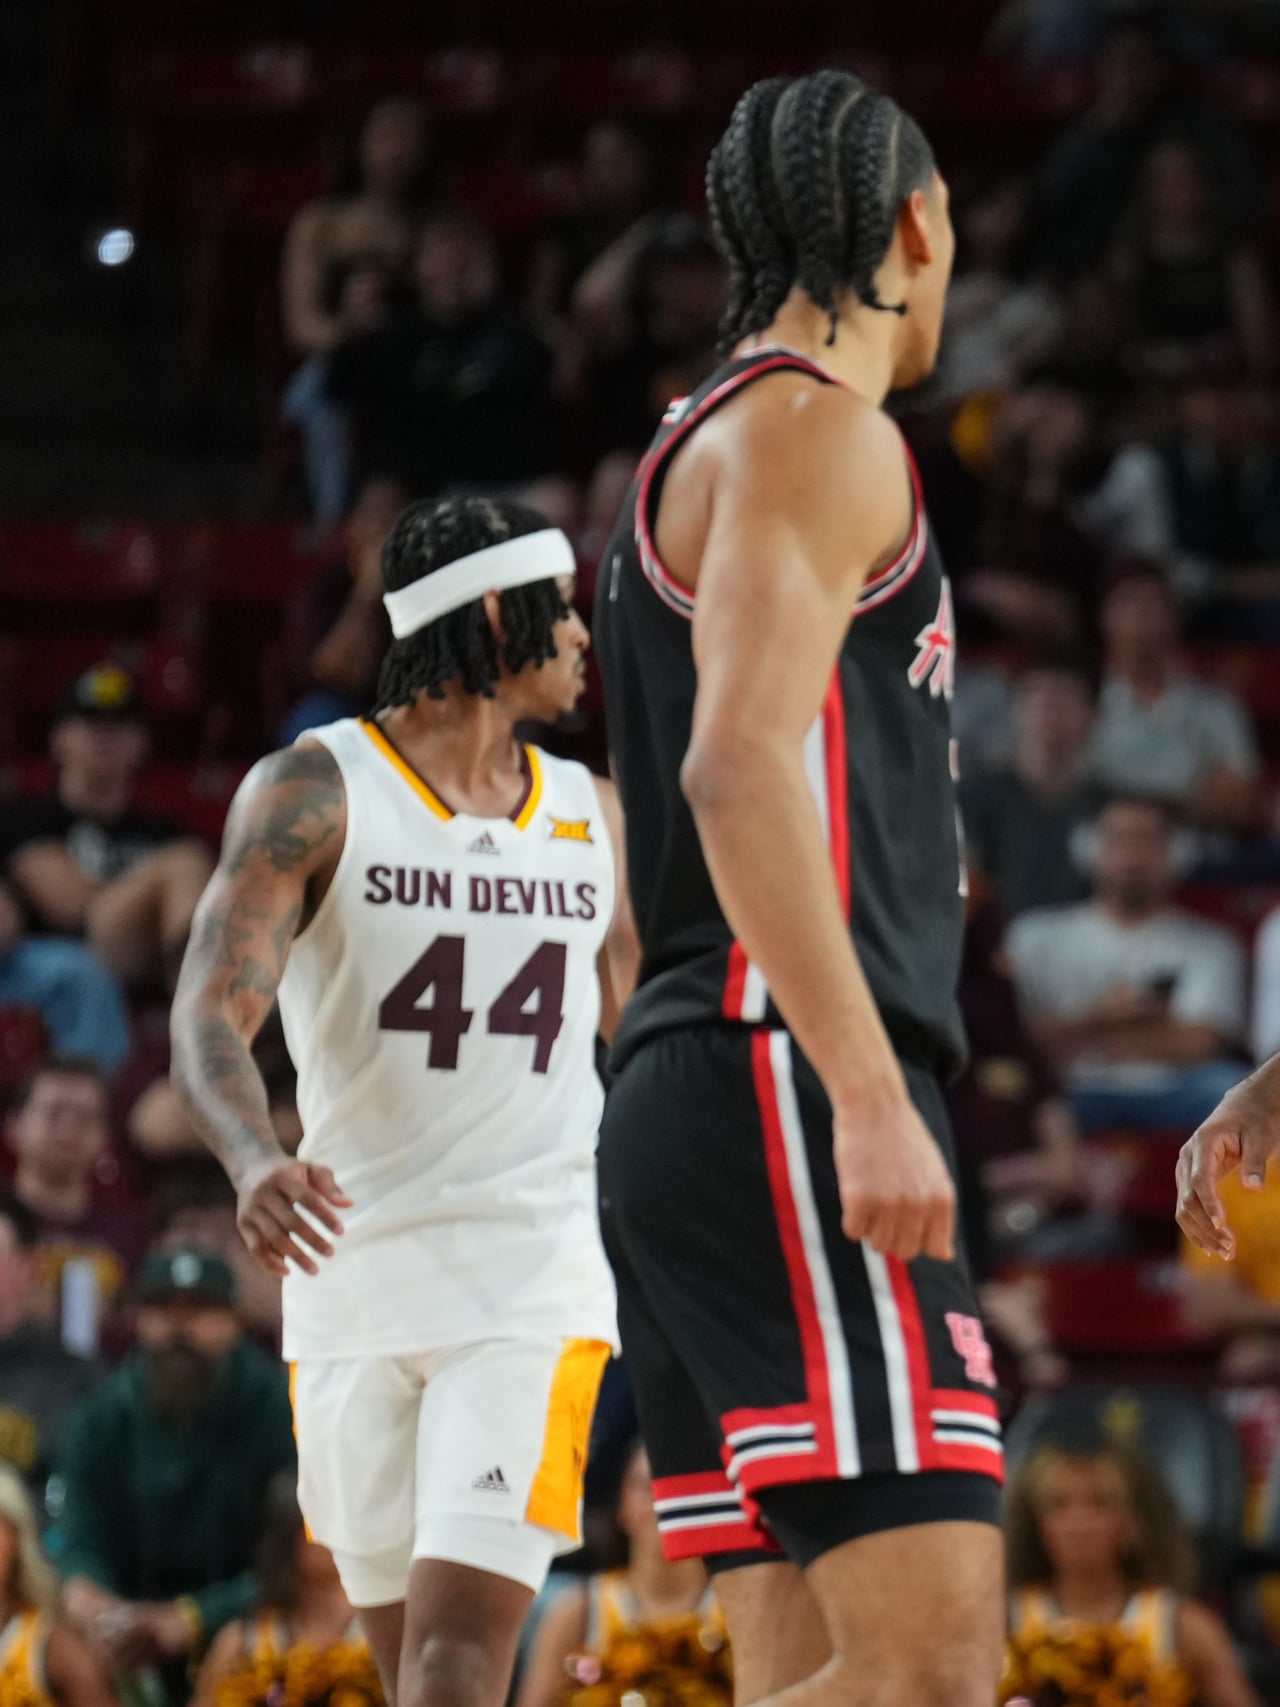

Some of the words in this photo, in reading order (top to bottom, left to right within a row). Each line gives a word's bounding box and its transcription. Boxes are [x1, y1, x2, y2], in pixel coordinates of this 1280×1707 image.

[364, 862, 452, 910] SUN
[467, 875, 598, 921] DEVILS
[378, 932, 568, 1074] 44
